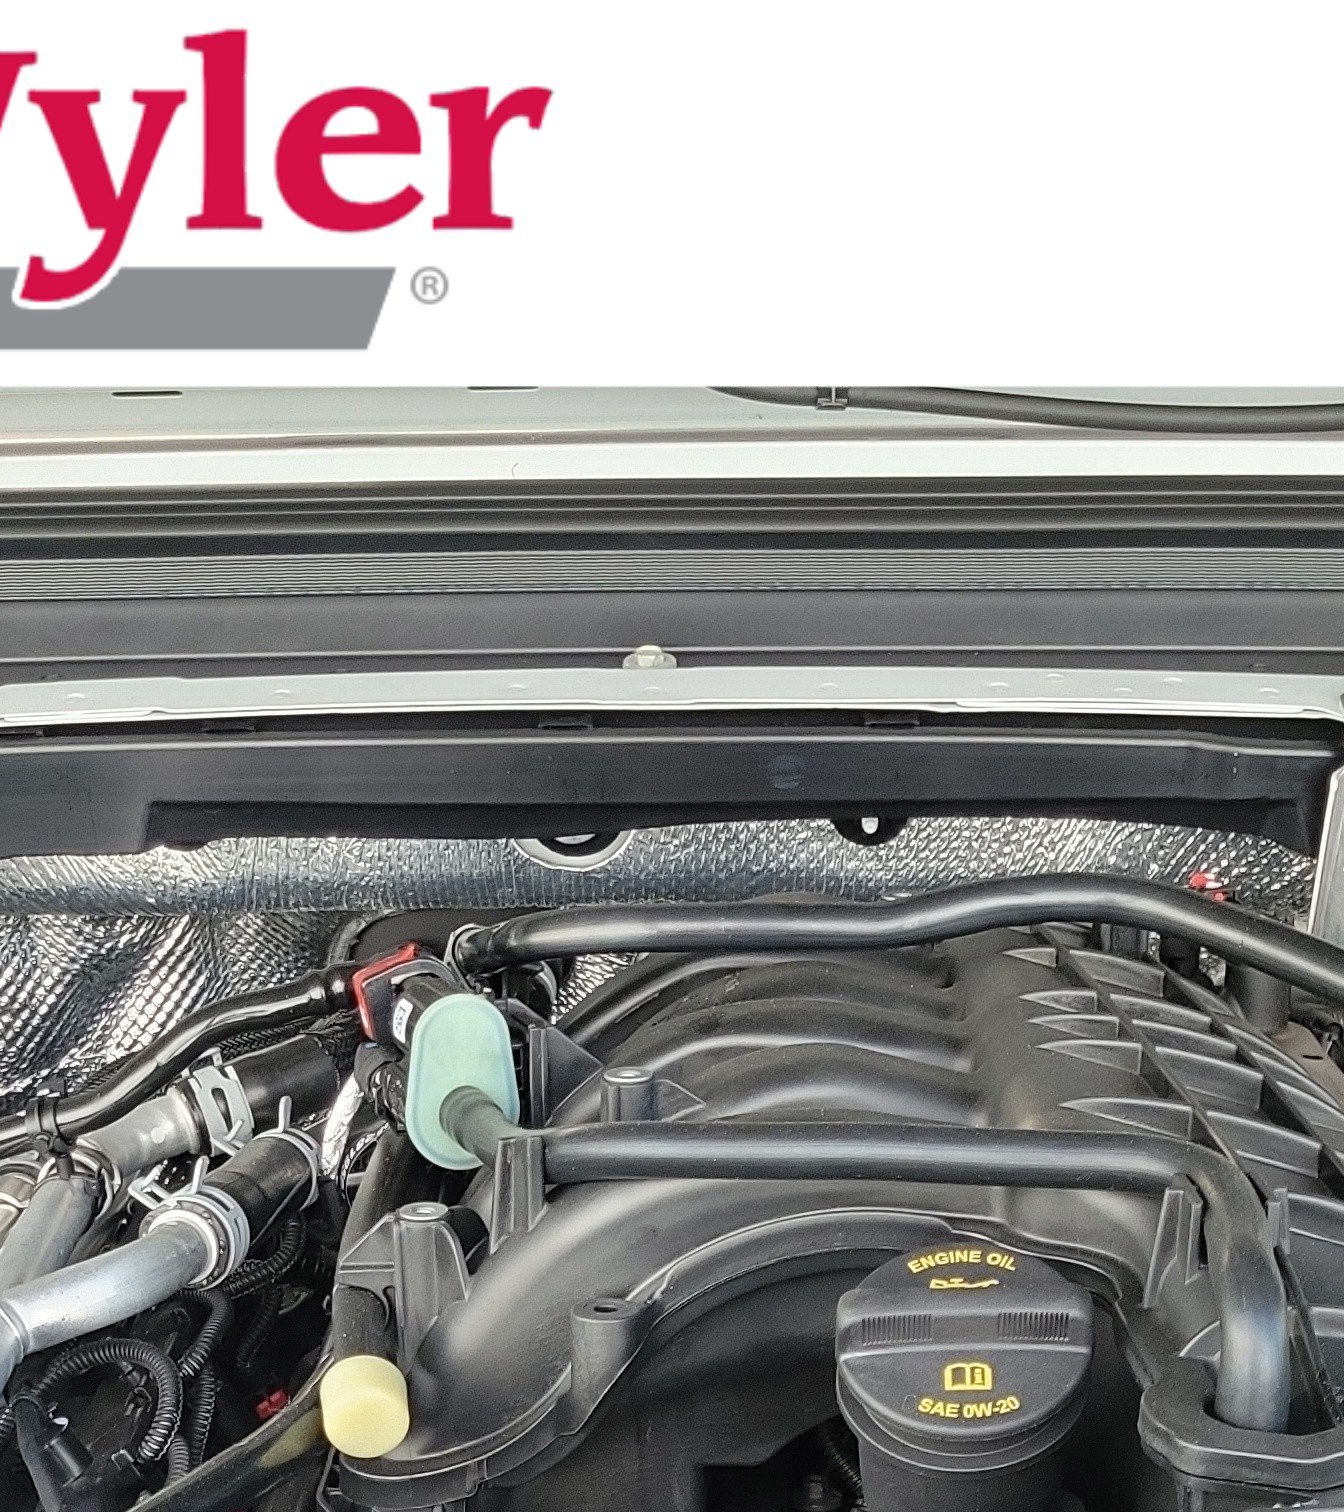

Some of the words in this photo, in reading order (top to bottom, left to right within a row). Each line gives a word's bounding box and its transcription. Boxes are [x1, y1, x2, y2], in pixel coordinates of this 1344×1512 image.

[907, 1250, 982, 1274] ENGINE
[987, 1252, 1016, 1271] OIL
[918, 1397, 959, 1418] SAE
[963, 1396, 1020, 1419] 0W-20
